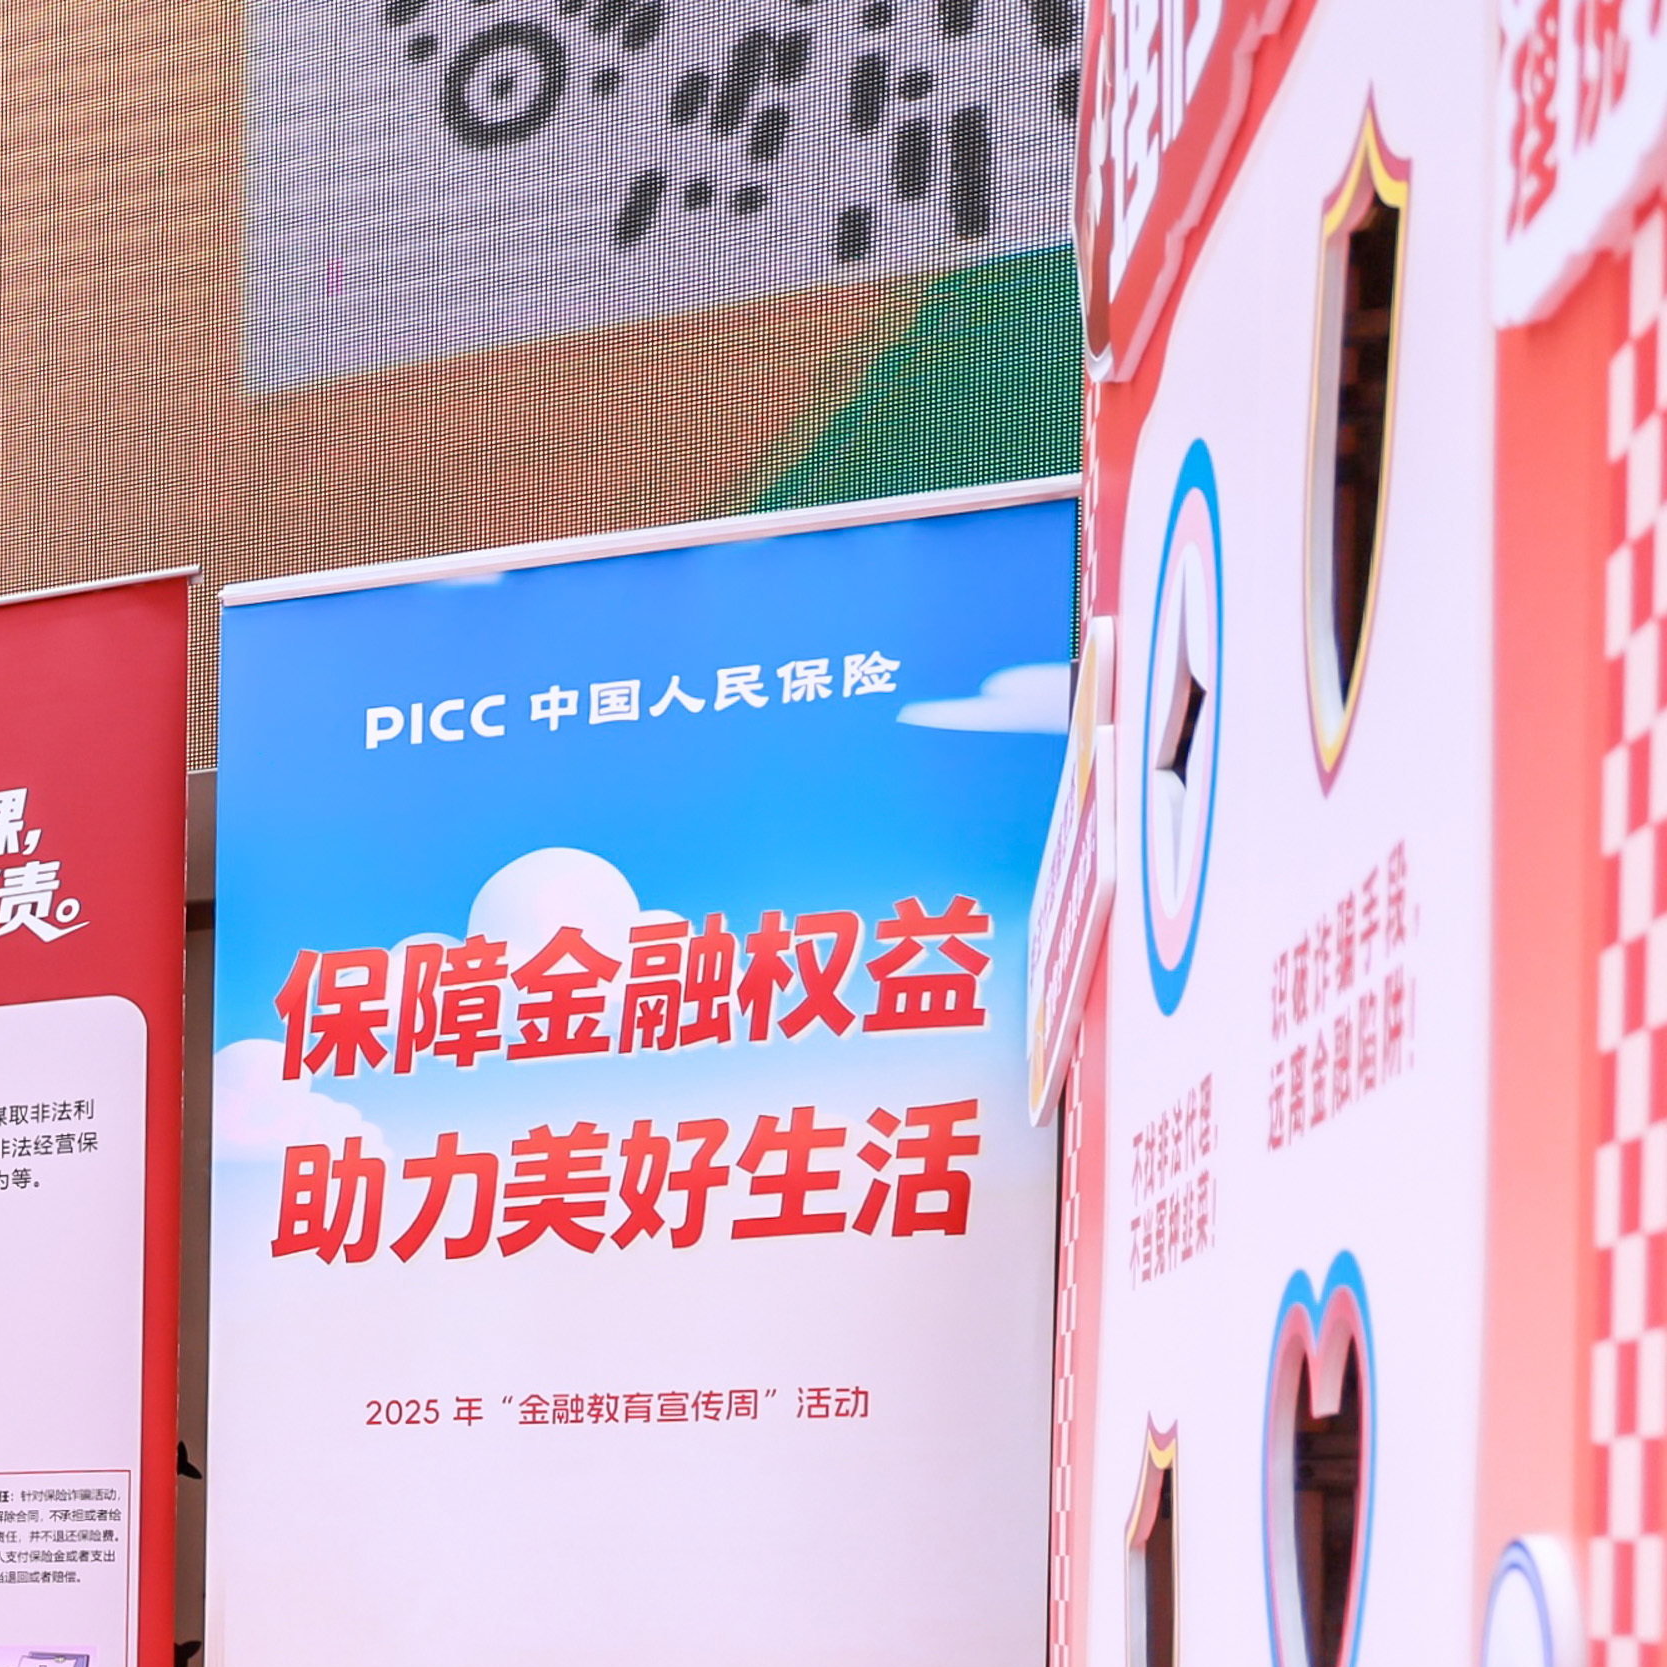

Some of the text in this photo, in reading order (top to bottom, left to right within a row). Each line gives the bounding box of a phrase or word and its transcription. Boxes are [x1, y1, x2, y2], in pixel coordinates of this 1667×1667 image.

[365, 650, 902, 751] PICC 中国人民保险
[273, 893, 993, 1081] 保障金融权益
[270, 1098, 982, 1265] 助力美好生活
[365, 1398, 441, 1426] 2025
[452, 1396, 485, 1427] 年
[796, 1386, 870, 1420] 活动
